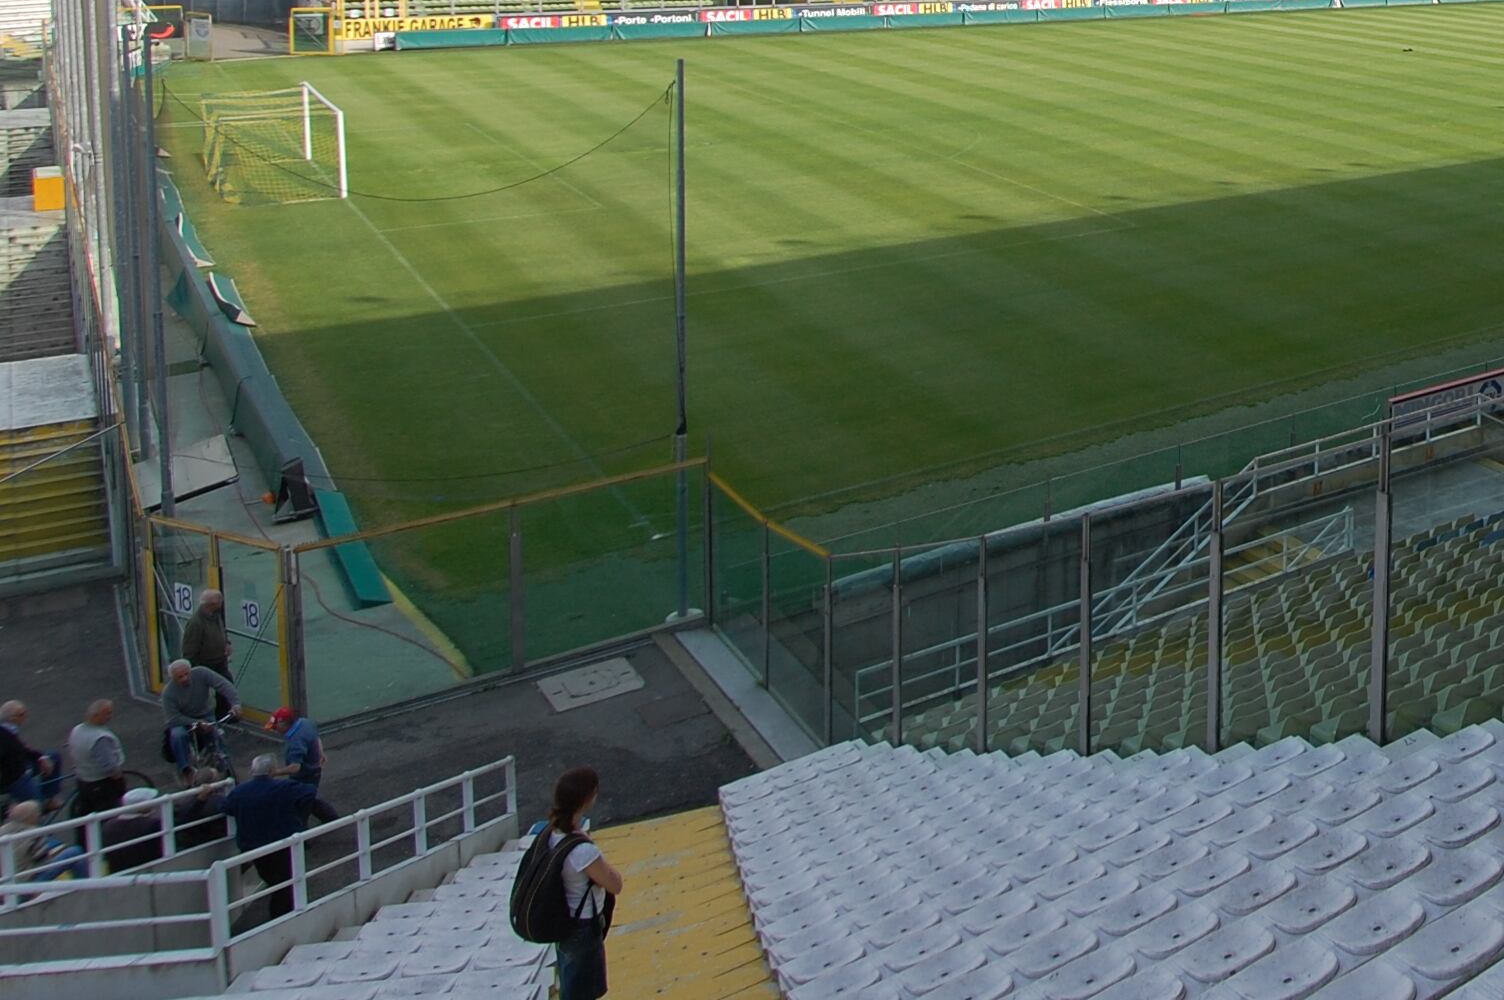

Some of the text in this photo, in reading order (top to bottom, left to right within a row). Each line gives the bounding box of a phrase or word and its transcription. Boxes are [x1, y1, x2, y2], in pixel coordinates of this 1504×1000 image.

[877, 3, 915, 16] SACIL
[1027, 0, 1058, 10] SACIL
[705, 10, 748, 22] SACIL
[801, 6, 866, 18] Tunnel Mobili
[506, 17, 553, 29] SACIL
[617, 13, 692, 25] Porte Portoni
[345, 16, 464, 38] FRANKIE GARAGE
[176, 586, 192, 612] 18
[241, 602, 259, 628] 18
